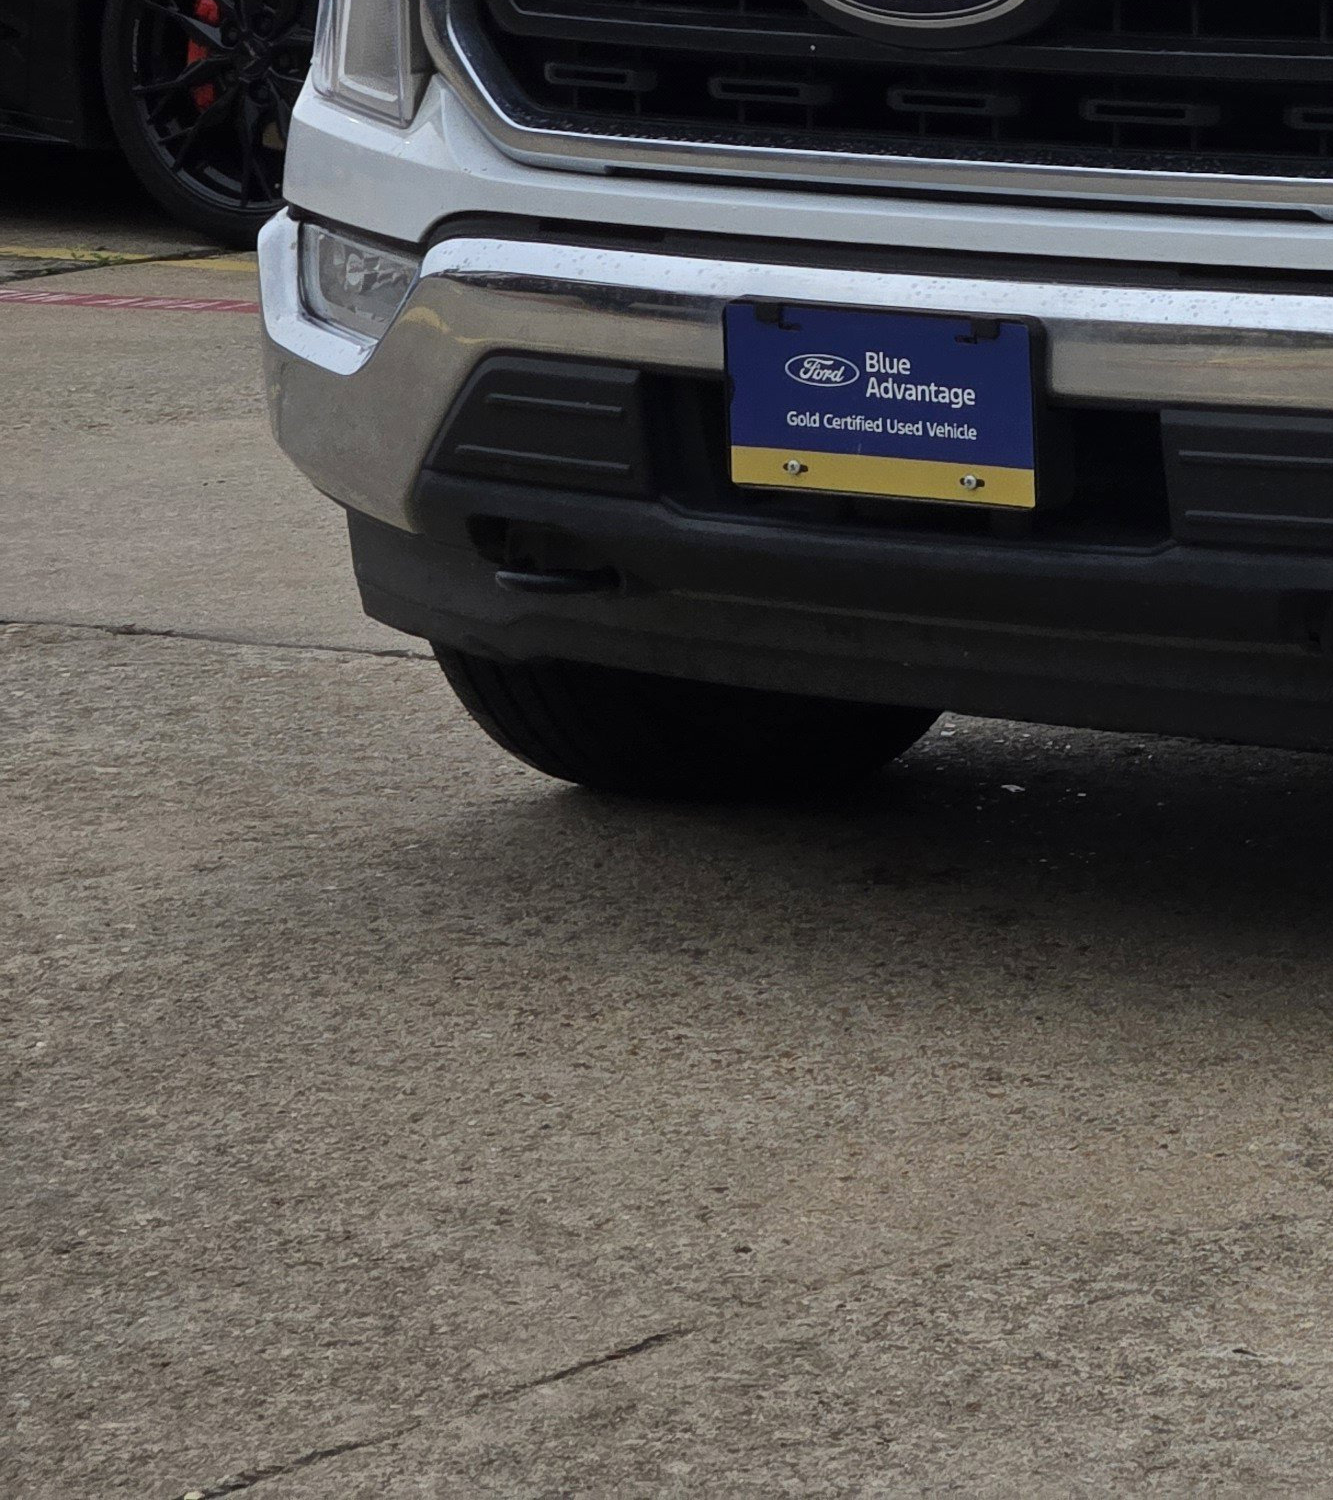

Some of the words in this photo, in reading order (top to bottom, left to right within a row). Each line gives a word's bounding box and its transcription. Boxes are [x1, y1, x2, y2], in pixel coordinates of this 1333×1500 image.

[800, 356, 845, 383] Ford
[865, 351, 911, 375] Blue
[866, 376, 976, 408] Advantage
[786, 411, 820, 427] Gold
[823, 414, 883, 433] Certified
[887, 419, 923, 436] Used
[926, 422, 977, 440] Vehicle
